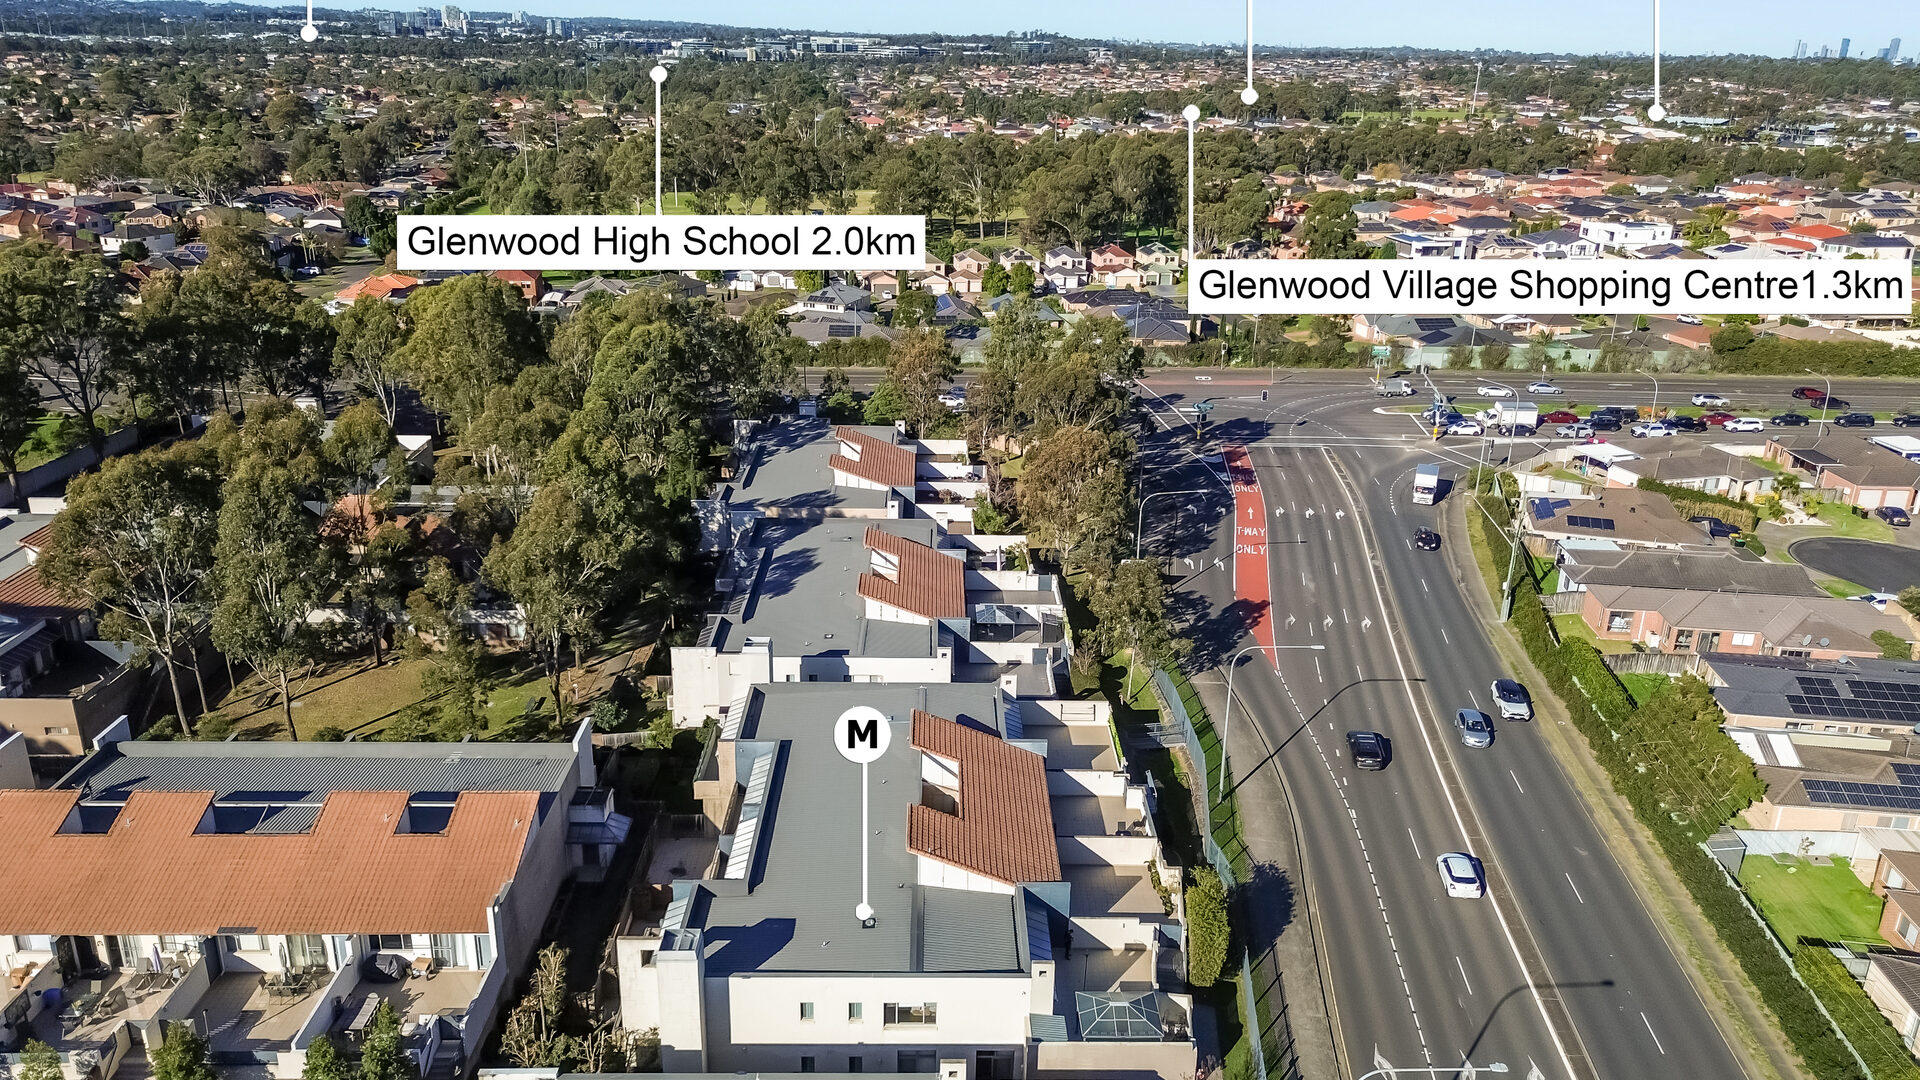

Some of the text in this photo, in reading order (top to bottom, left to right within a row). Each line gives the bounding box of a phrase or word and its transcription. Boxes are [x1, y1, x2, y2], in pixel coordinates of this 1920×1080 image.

[1235, 485, 1259, 493] ONLY
[1236, 526, 1266, 537] T-WAY
[1236, 544, 1266, 555] ONLY
